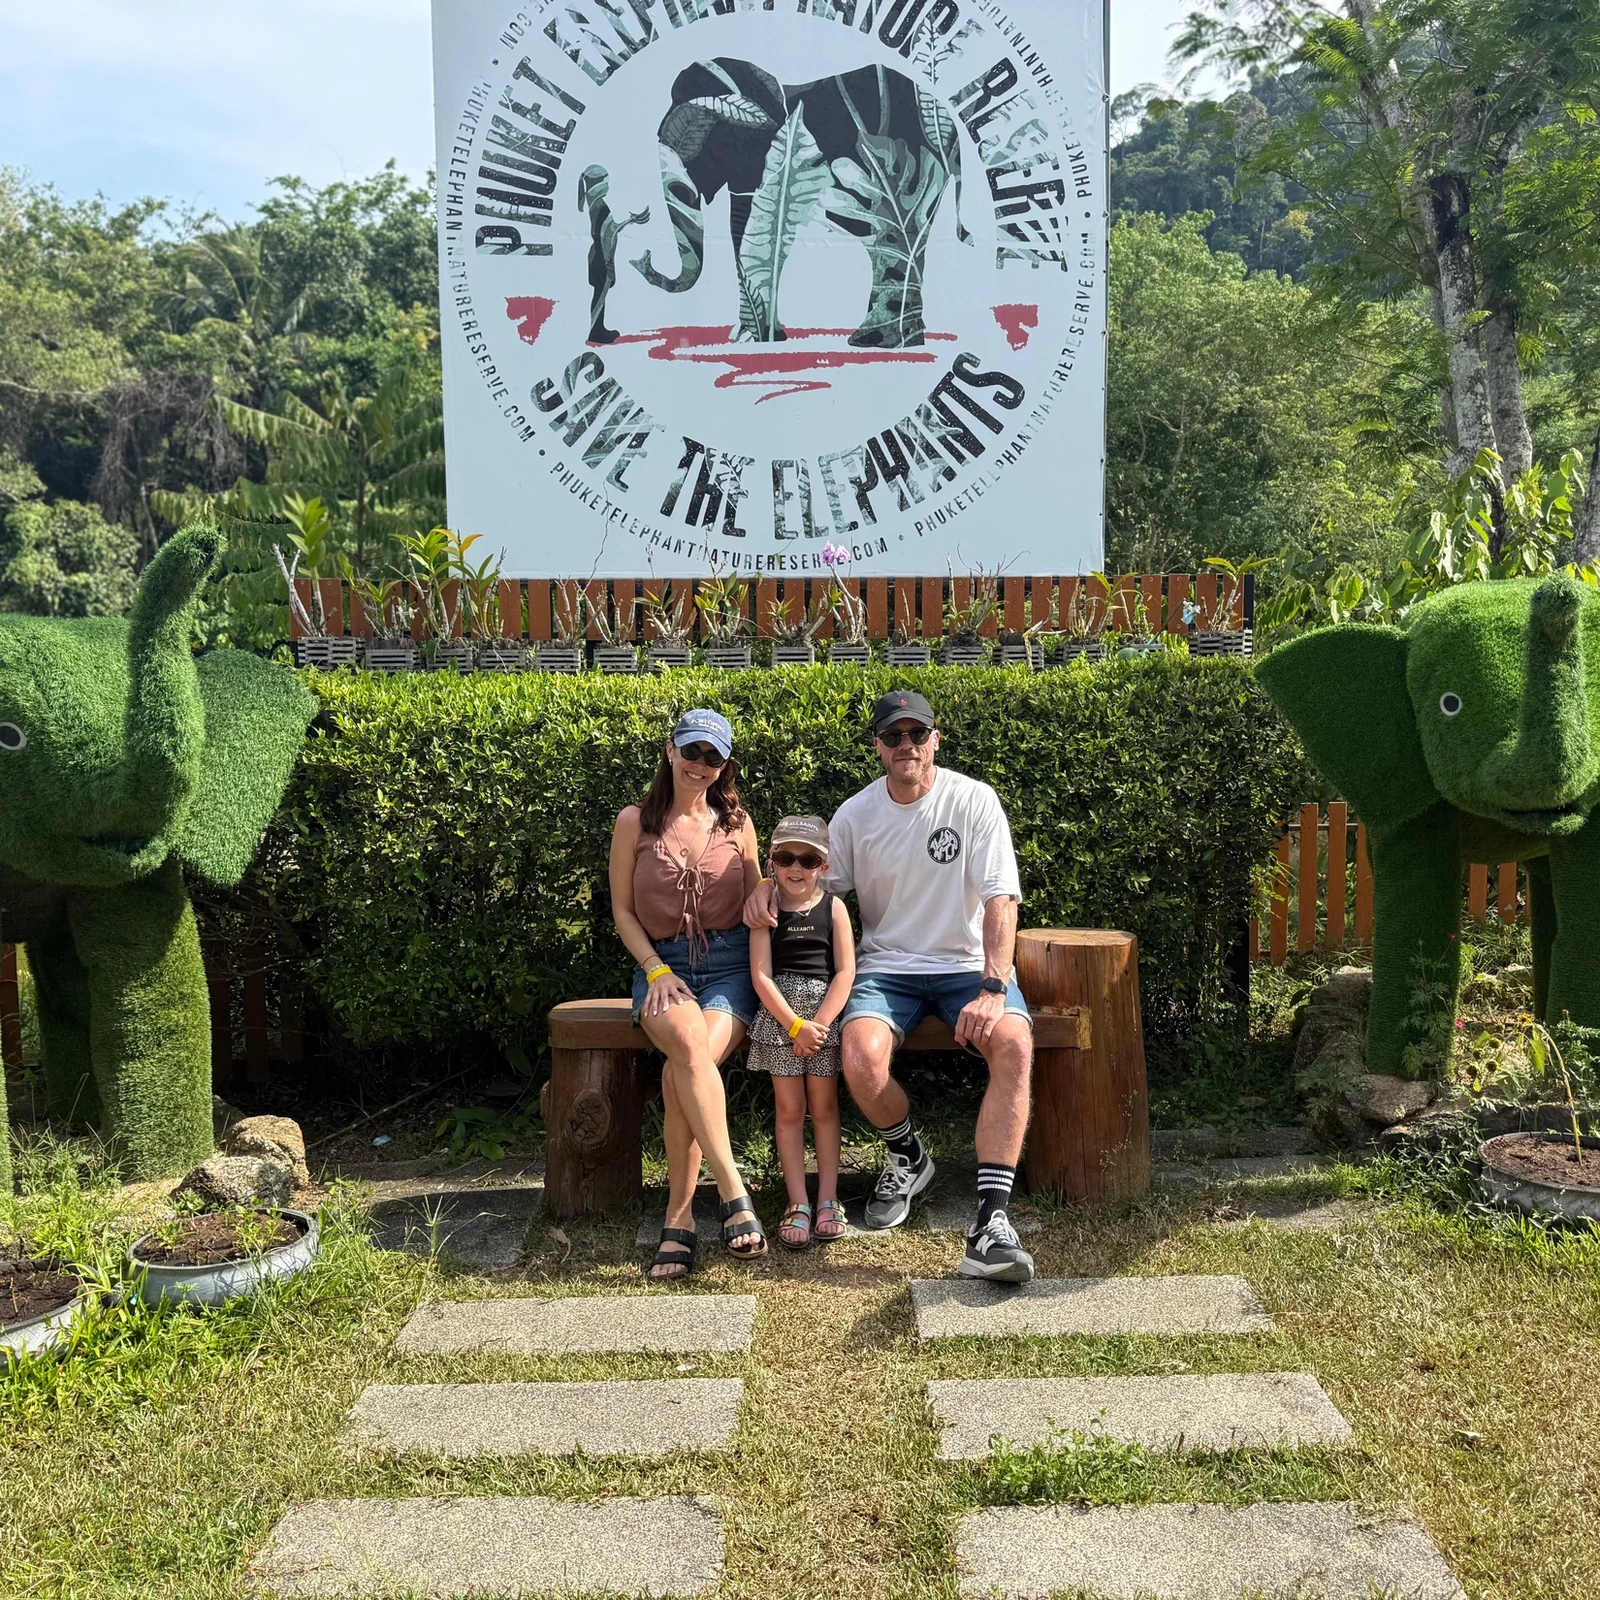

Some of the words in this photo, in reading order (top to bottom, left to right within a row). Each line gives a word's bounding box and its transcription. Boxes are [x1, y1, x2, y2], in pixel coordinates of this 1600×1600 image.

[474, 55, 586, 256] PHUKET
[543, 0, 775, 87] ELEP
[948, 56, 1069, 273] RESERVE
[530, 351, 667, 493] SAVE
[660, 436, 755, 538] THE
[771, 352, 1025, 540] ELEPHANTS
[550, 461, 889, 571] PHUKETELEPHANTNATURERESERE.COM
